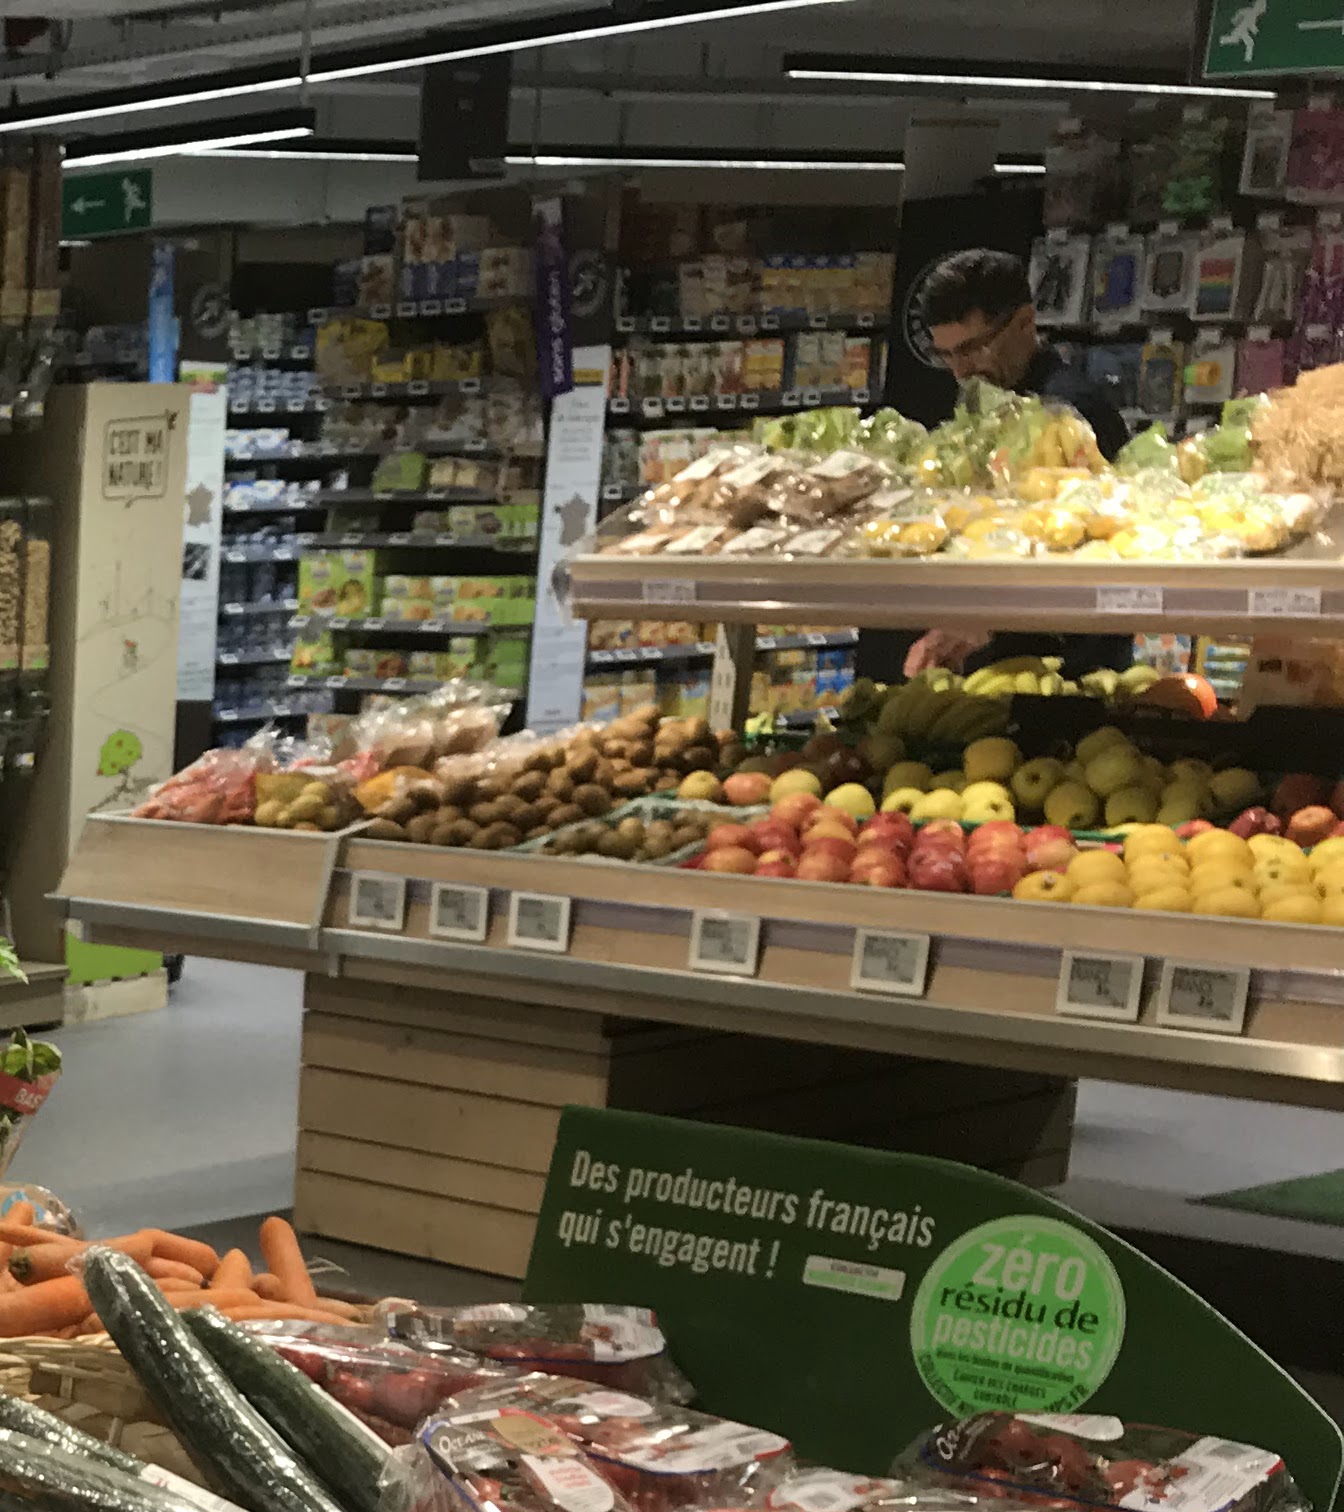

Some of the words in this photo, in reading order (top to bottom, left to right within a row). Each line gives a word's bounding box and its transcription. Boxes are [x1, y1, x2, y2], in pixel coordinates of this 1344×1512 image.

[571, 1150, 621, 1193] Des
[626, 1167, 800, 1226] producteurs
[806, 1188, 936, 1251] français
[558, 1208, 603, 1247] qui
[605, 1213, 761, 1276] s'engagent
[971, 1232, 1088, 1300] zéro
[940, 1280, 1048, 1324] résidu
[1053, 1299, 1100, 1335] de
[930, 1313, 1094, 1371] pesticides
